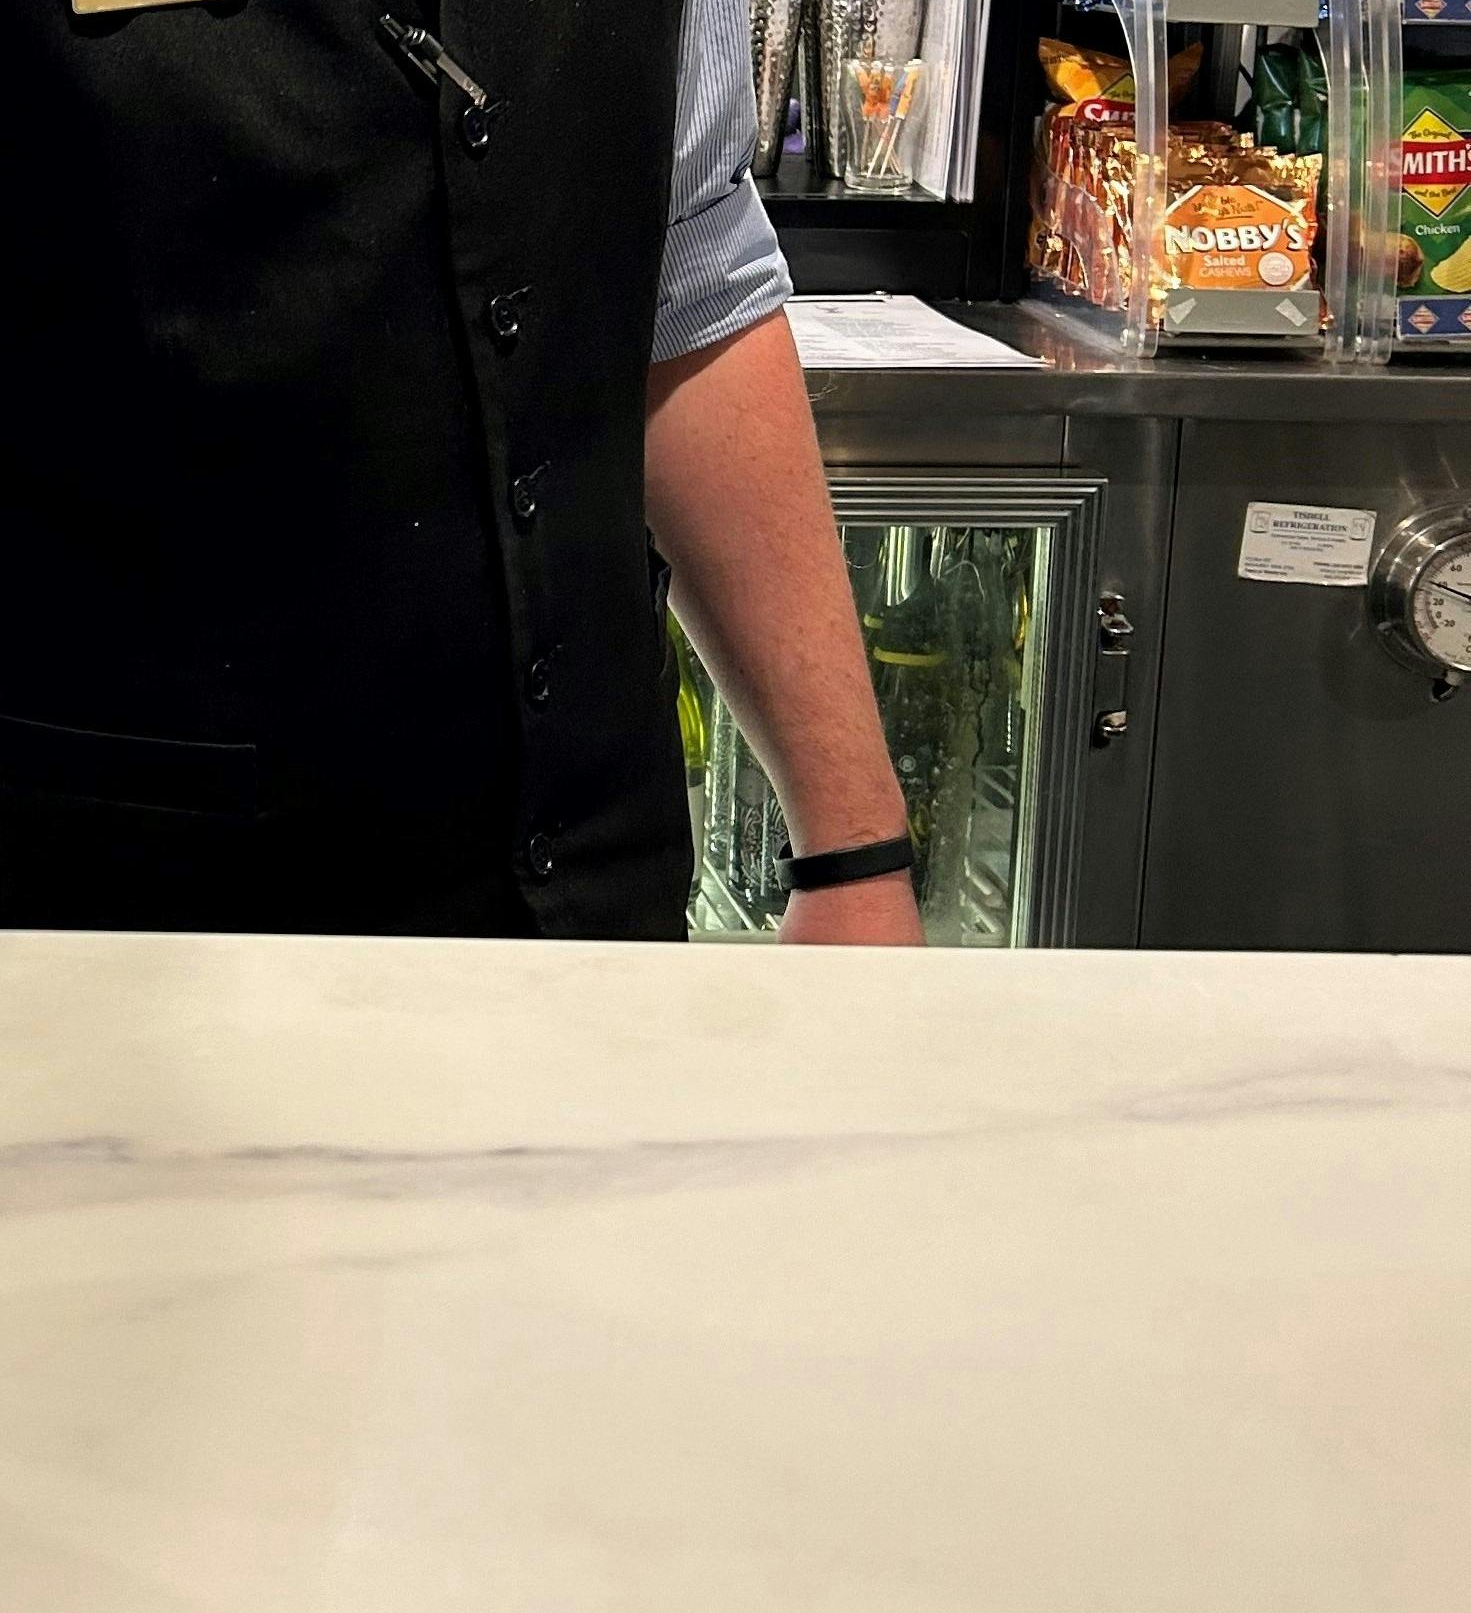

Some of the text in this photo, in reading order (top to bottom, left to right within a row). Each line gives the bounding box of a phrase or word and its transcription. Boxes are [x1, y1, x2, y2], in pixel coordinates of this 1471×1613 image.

[1415, 223, 1461, 236] Chicken
[1164, 218, 1304, 255] NOBBY'S
[1203, 255, 1246, 267] Salted
[1199, 266, 1251, 277] CASHEWS
[1450, 564, 1463, 572] 60
[1432, 598, 1444, 606] 20
